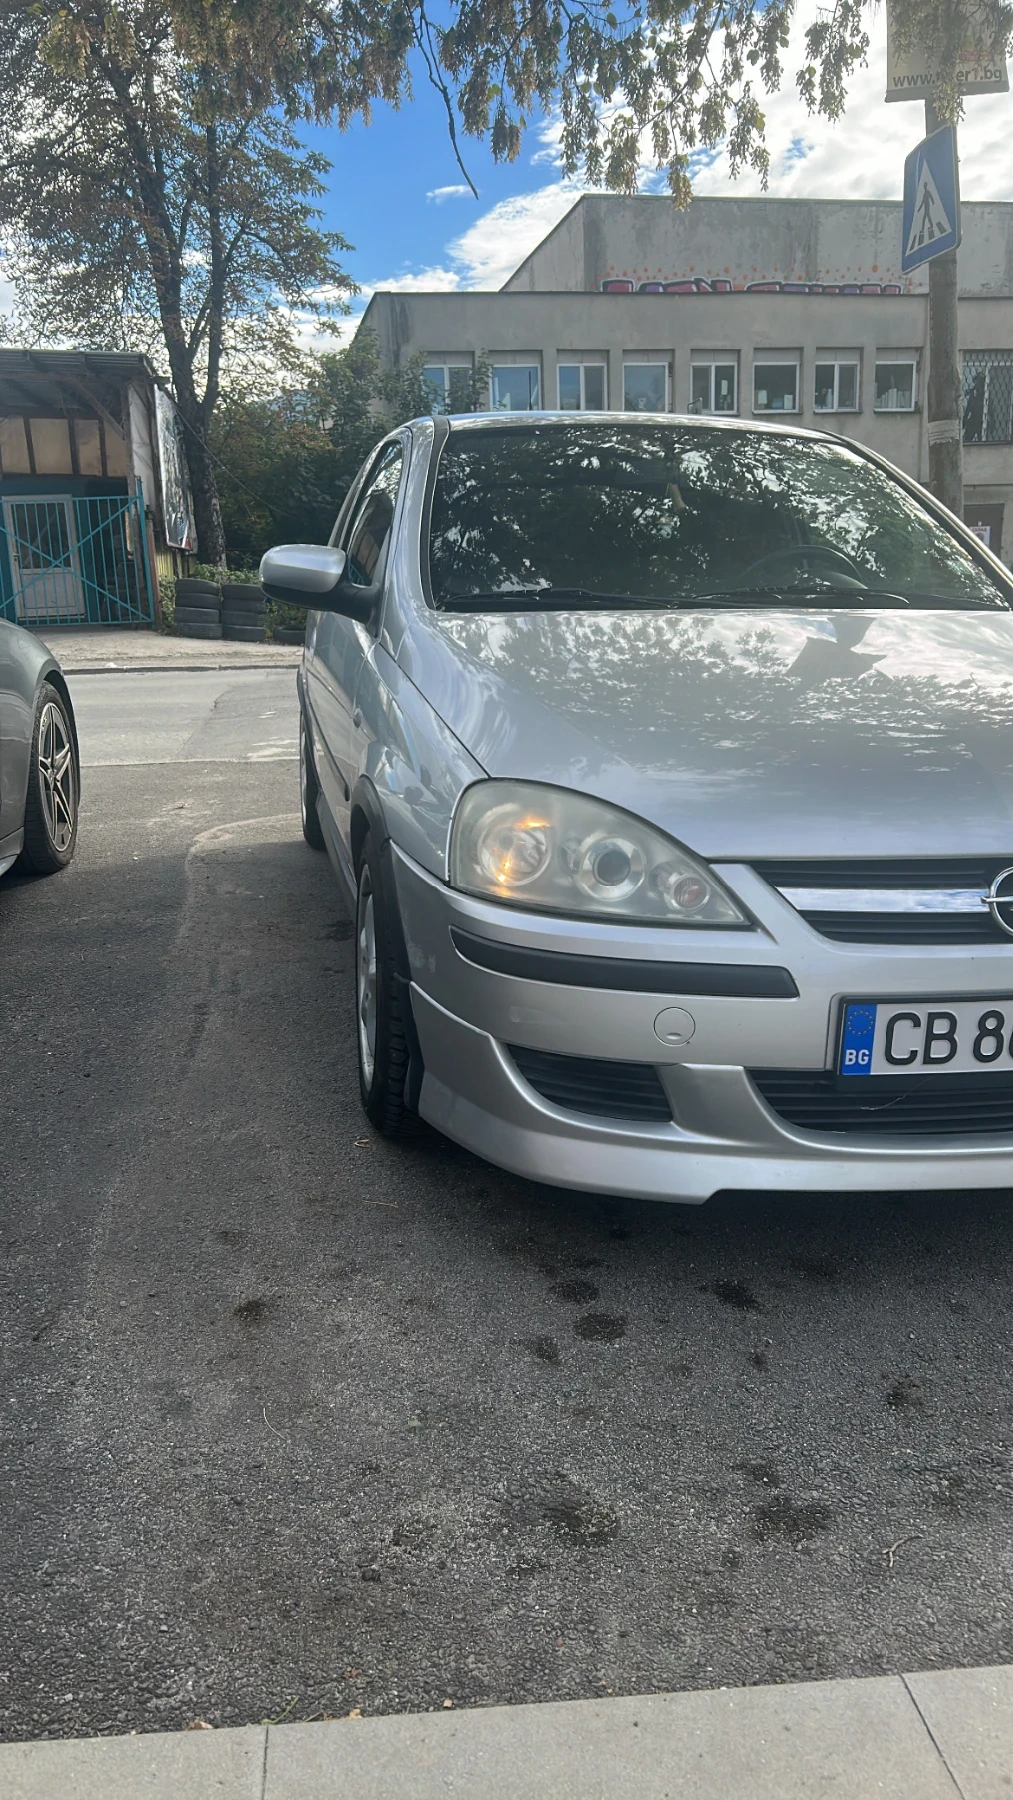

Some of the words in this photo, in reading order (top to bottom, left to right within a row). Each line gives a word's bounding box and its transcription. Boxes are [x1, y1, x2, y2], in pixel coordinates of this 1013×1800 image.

[892, 66, 1003, 88] www.er1.bg
[885, 1011, 958, 1065] CB
[973, 1010, 1013, 1063] 8
[844, 1049, 870, 1066] BG
